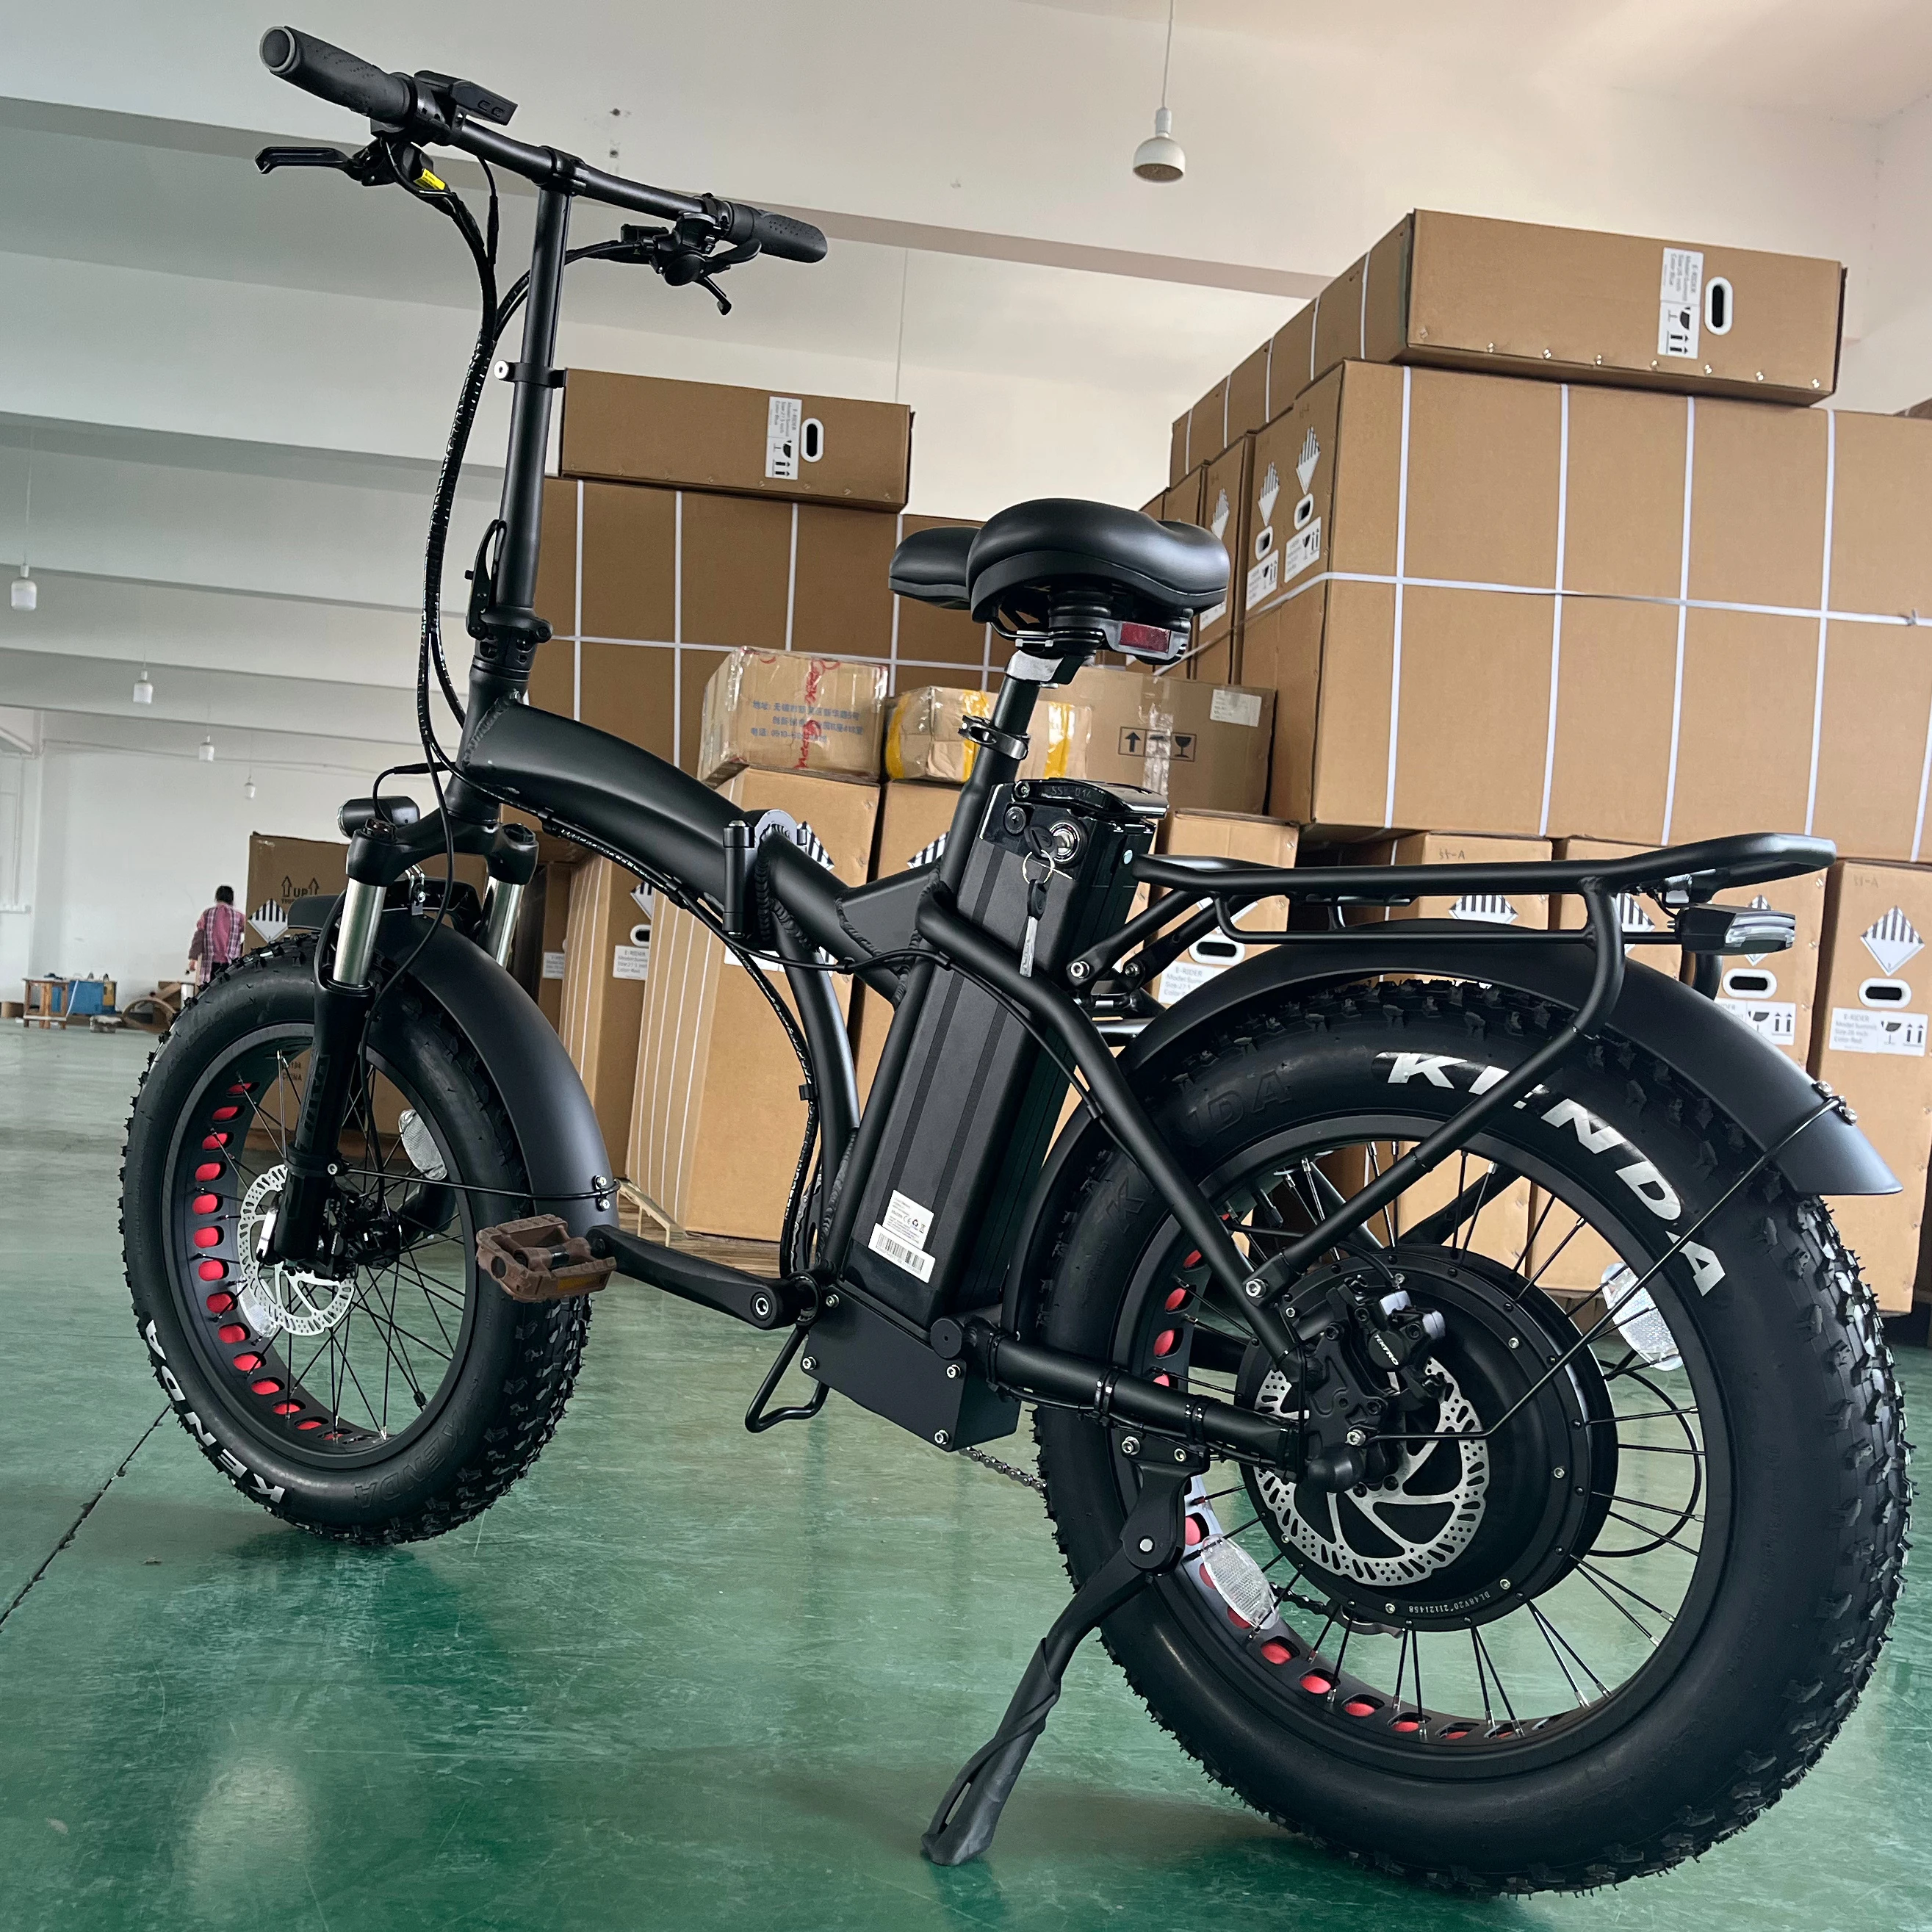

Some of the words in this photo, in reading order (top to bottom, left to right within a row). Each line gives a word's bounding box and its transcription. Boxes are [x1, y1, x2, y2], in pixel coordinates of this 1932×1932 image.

[294, 887, 308, 897] UP
[1374, 1333, 1399, 1366] TEKTRO
[145, 1319, 285, 1504] KENDA
